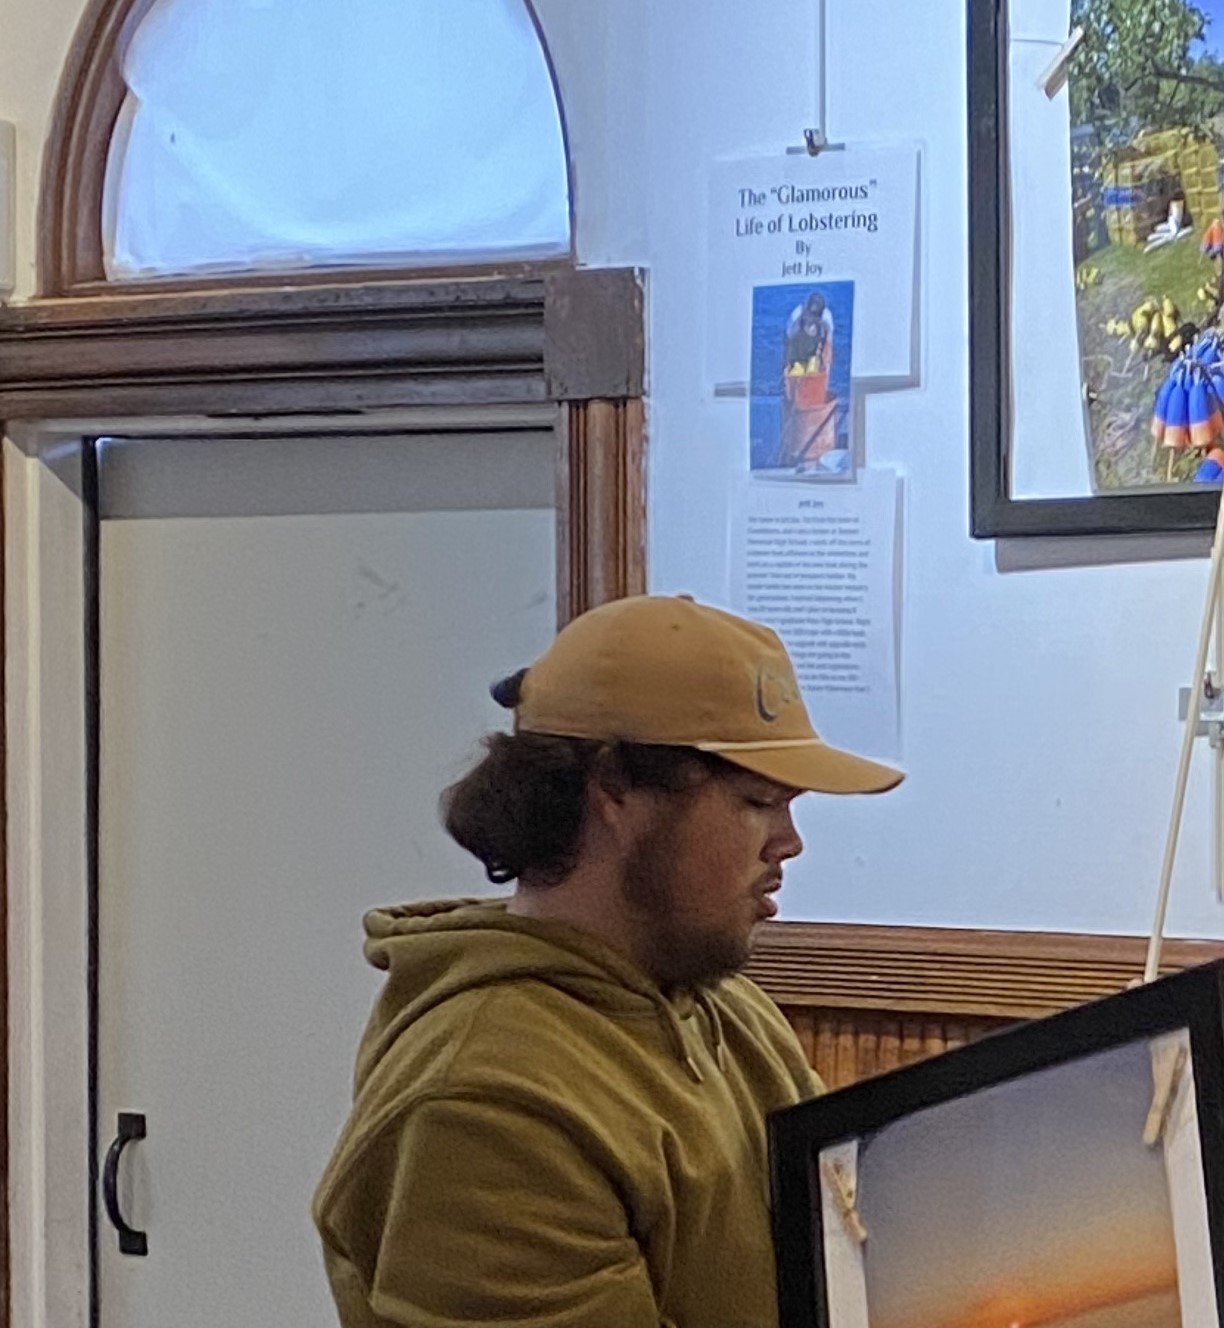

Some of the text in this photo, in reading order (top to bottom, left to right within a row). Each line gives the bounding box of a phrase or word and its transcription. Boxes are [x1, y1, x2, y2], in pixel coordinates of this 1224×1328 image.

[738, 178, 877, 208] The “Glamorous”
[736, 210, 879, 237] Life of Lobstering
[795, 240, 811, 257] By
